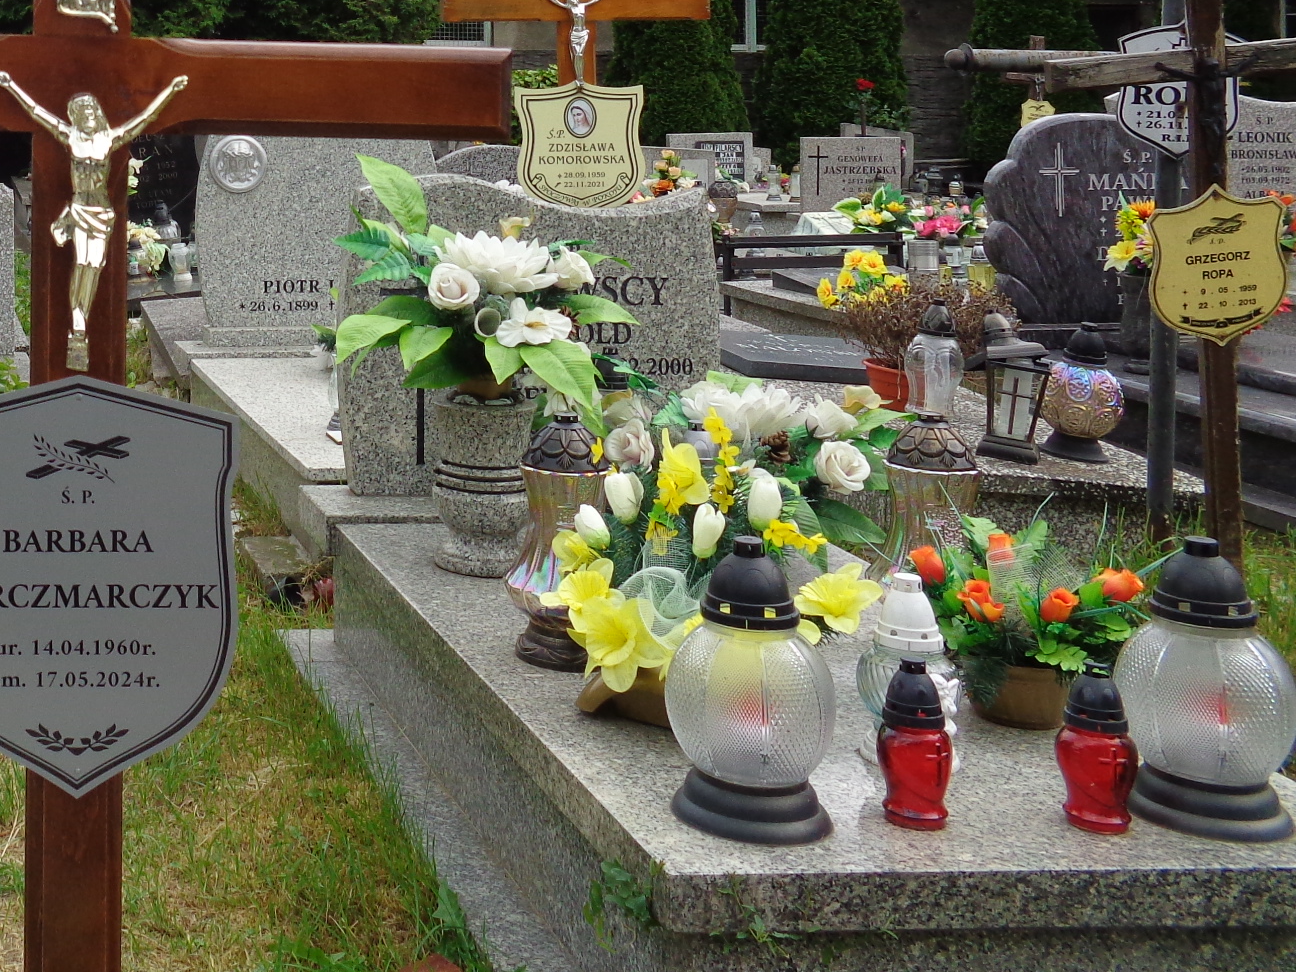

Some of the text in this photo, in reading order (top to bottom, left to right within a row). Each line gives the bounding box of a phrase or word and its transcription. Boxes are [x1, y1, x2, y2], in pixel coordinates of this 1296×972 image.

[1161, 134, 1189, 143] R.I.
[548, 143, 615, 152] ZDZISŁAWA
[538, 155, 625, 165] KOMOROWSKA
[1185, 251, 1251, 266] GRZEGORZ
[1202, 269, 1234, 280] ROPA
[263, 279, 320, 293] PIOTR
[621, 358, 693, 376] 2.2000
[61, 486, 95, 505] Ś. P.
[3, 529, 154, 554] BARBARA
[31, 639, 156, 657] 14.04.1960r.
[36, 671, 160, 689] 17.05.2024r.
